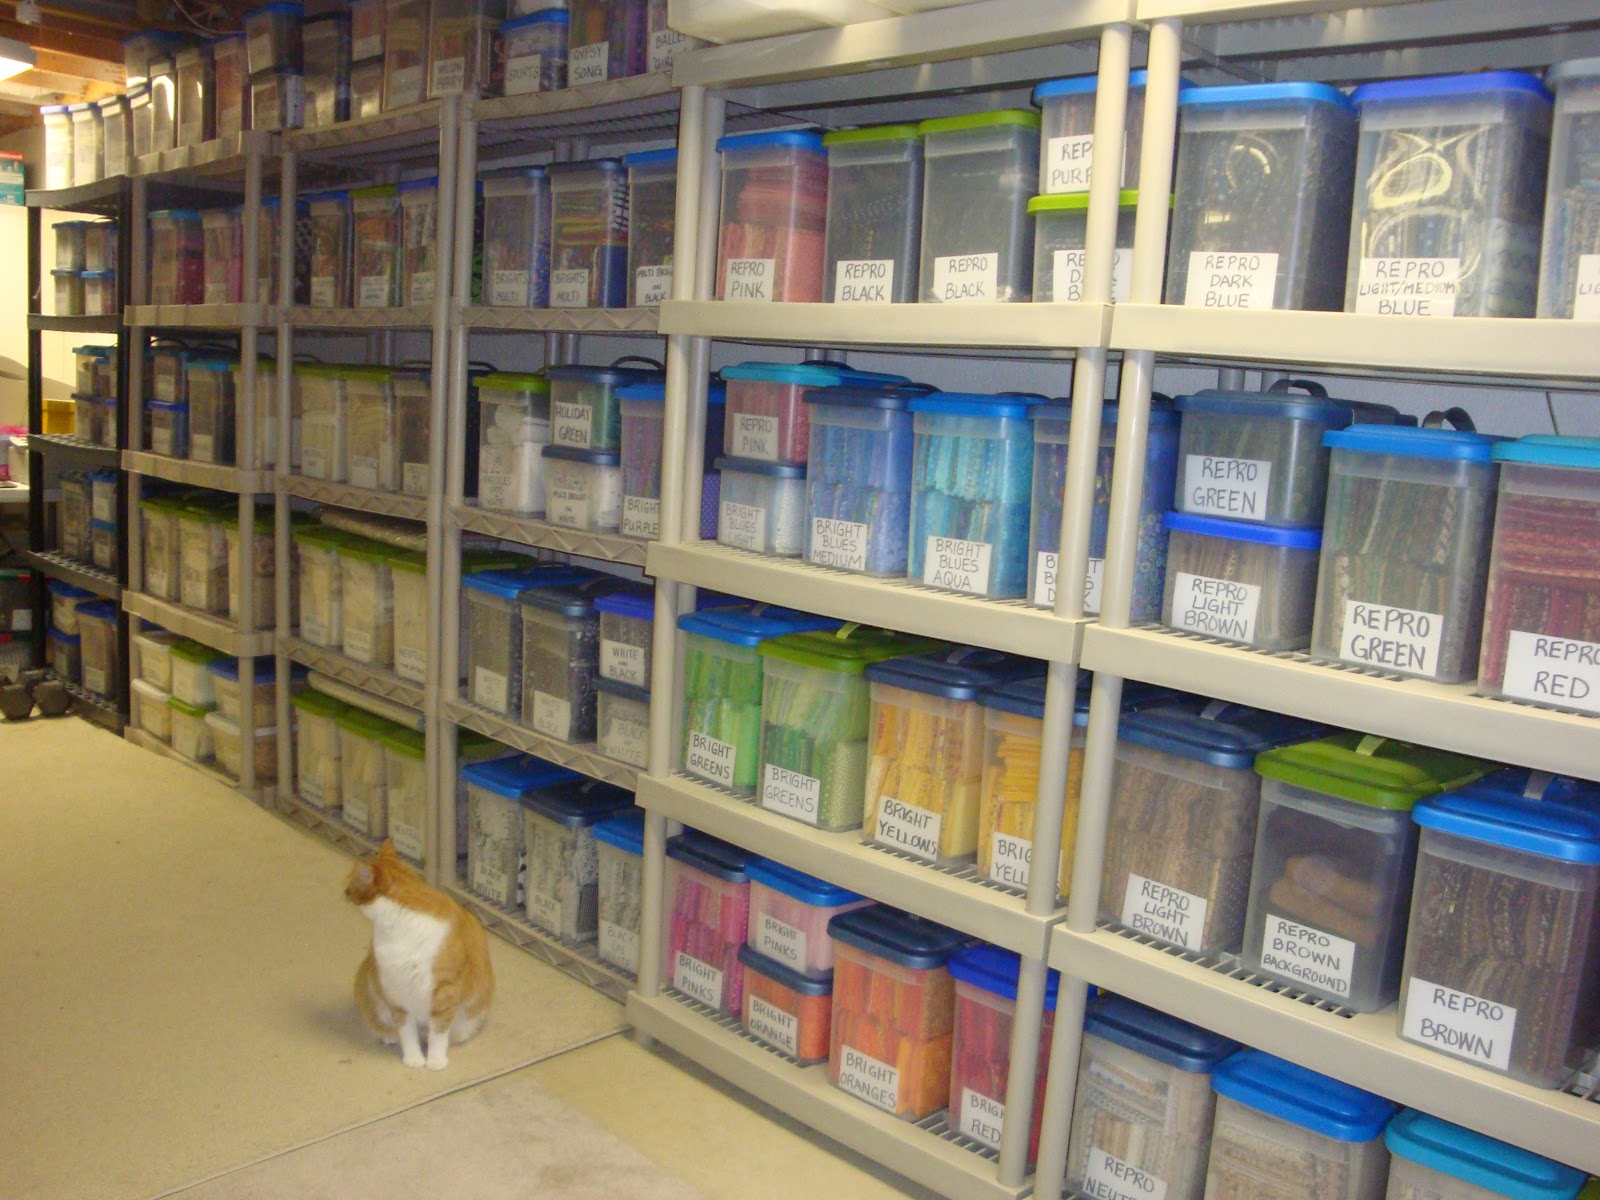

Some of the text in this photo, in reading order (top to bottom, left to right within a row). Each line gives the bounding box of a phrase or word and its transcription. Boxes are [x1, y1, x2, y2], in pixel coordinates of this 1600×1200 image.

[574, 65, 603, 80] SONG
[1061, 141, 1093, 161] REP
[1052, 168, 1092, 187] PURP
[731, 261, 765, 277] REPRO
[844, 263, 886, 279] REPRO
[949, 256, 988, 273] REPRO
[1204, 255, 1260, 271] REPRO
[1376, 260, 1445, 279] REPRO
[731, 281, 766, 299] PINK
[945, 281, 985, 300] BLACK
[1210, 274, 1253, 288] DARK
[841, 285, 885, 301] BLACK
[1204, 291, 1250, 308] BLUE
[1378, 299, 1431, 316] BLUE
[559, 426, 588, 444] GREEN
[740, 416, 773, 433] REPRO
[742, 437, 769, 455] PINK
[1202, 457, 1258, 483] REPRO
[1192, 486, 1256, 514] GREEN
[726, 503, 761, 521] BRIGHT
[623, 518, 658, 536] PURPLE
[729, 518, 757, 534] BLUES
[816, 520, 863, 540] BRIGHT
[822, 534, 858, 553] BLUES
[935, 538, 986, 559] BRIGHT
[812, 550, 863, 569] MEDIUM
[939, 554, 979, 573] BLUES
[932, 571, 973, 591] AQUA
[1192, 578, 1248, 601] REPRO
[1192, 595, 1244, 617] LIGHT
[1183, 610, 1248, 639] BROWN
[1353, 604, 1431, 638] REPRO
[612, 646, 639, 661] WHITE
[1350, 634, 1426, 671] GREEN
[609, 664, 637, 681] BLACK
[1534, 671, 1590, 699] RED
[693, 734, 733, 760] BRIGHT
[690, 753, 730, 780] GREENS
[771, 767, 816, 793] BRIGHT
[765, 785, 814, 813] GREENS
[884, 799, 933, 830] BRIGHT
[879, 819, 937, 855] YELLOWS
[997, 839, 1032, 864] BRIG
[995, 861, 1029, 887] YELL
[1141, 880, 1190, 912] REPRO
[1144, 901, 1190, 926] LIGHT
[765, 918, 798, 941] BRIGHT
[1132, 913, 1188, 947] BROWN
[1277, 920, 1330, 947] REPRO
[764, 935, 798, 961] PINKS
[1272, 937, 1341, 971] BROWN
[679, 955, 718, 982] BRIGHT
[1263, 953, 1348, 993] BACKGROUND
[682, 976, 714, 1002] PINKS
[752, 999, 793, 1029] BRIGHT
[1432, 988, 1503, 1021] REPRO
[750, 1018, 793, 1050] ORANGE
[1420, 1018, 1493, 1059] BROWN
[846, 1052, 897, 1085] BRIGHT
[839, 1072, 896, 1109] ORANGES
[1104, 1156, 1155, 1193] REPRO
